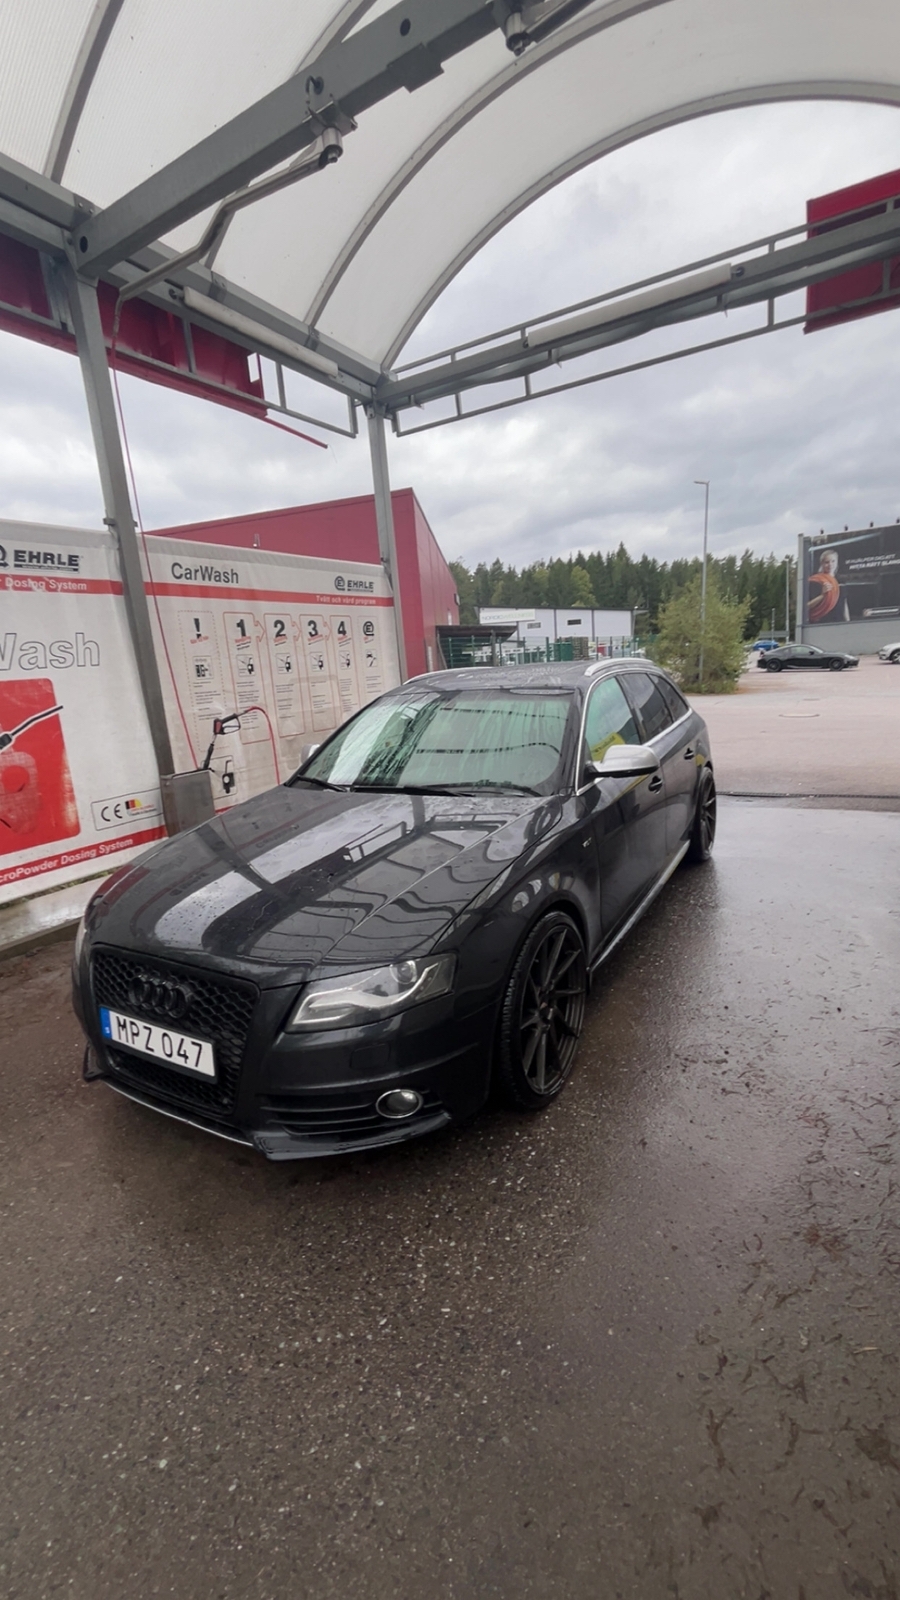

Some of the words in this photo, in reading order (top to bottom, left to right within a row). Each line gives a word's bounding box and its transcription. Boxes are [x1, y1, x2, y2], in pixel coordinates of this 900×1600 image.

[14, 549, 79, 567] EHRLE
[171, 562, 239, 584] CarWash
[49, 579, 87, 591] System
[347, 580, 374, 589] EHRLE
[236, 619, 247, 637] 1
[274, 619, 286, 638] 2
[307, 620, 319, 637] 3
[337, 620, 347, 636] 4
[60, 848, 97, 865] Dosing
[99, 838, 133, 855] System
[115, 1015, 155, 1053] MPZ
[161, 1032, 202, 1068] 047
